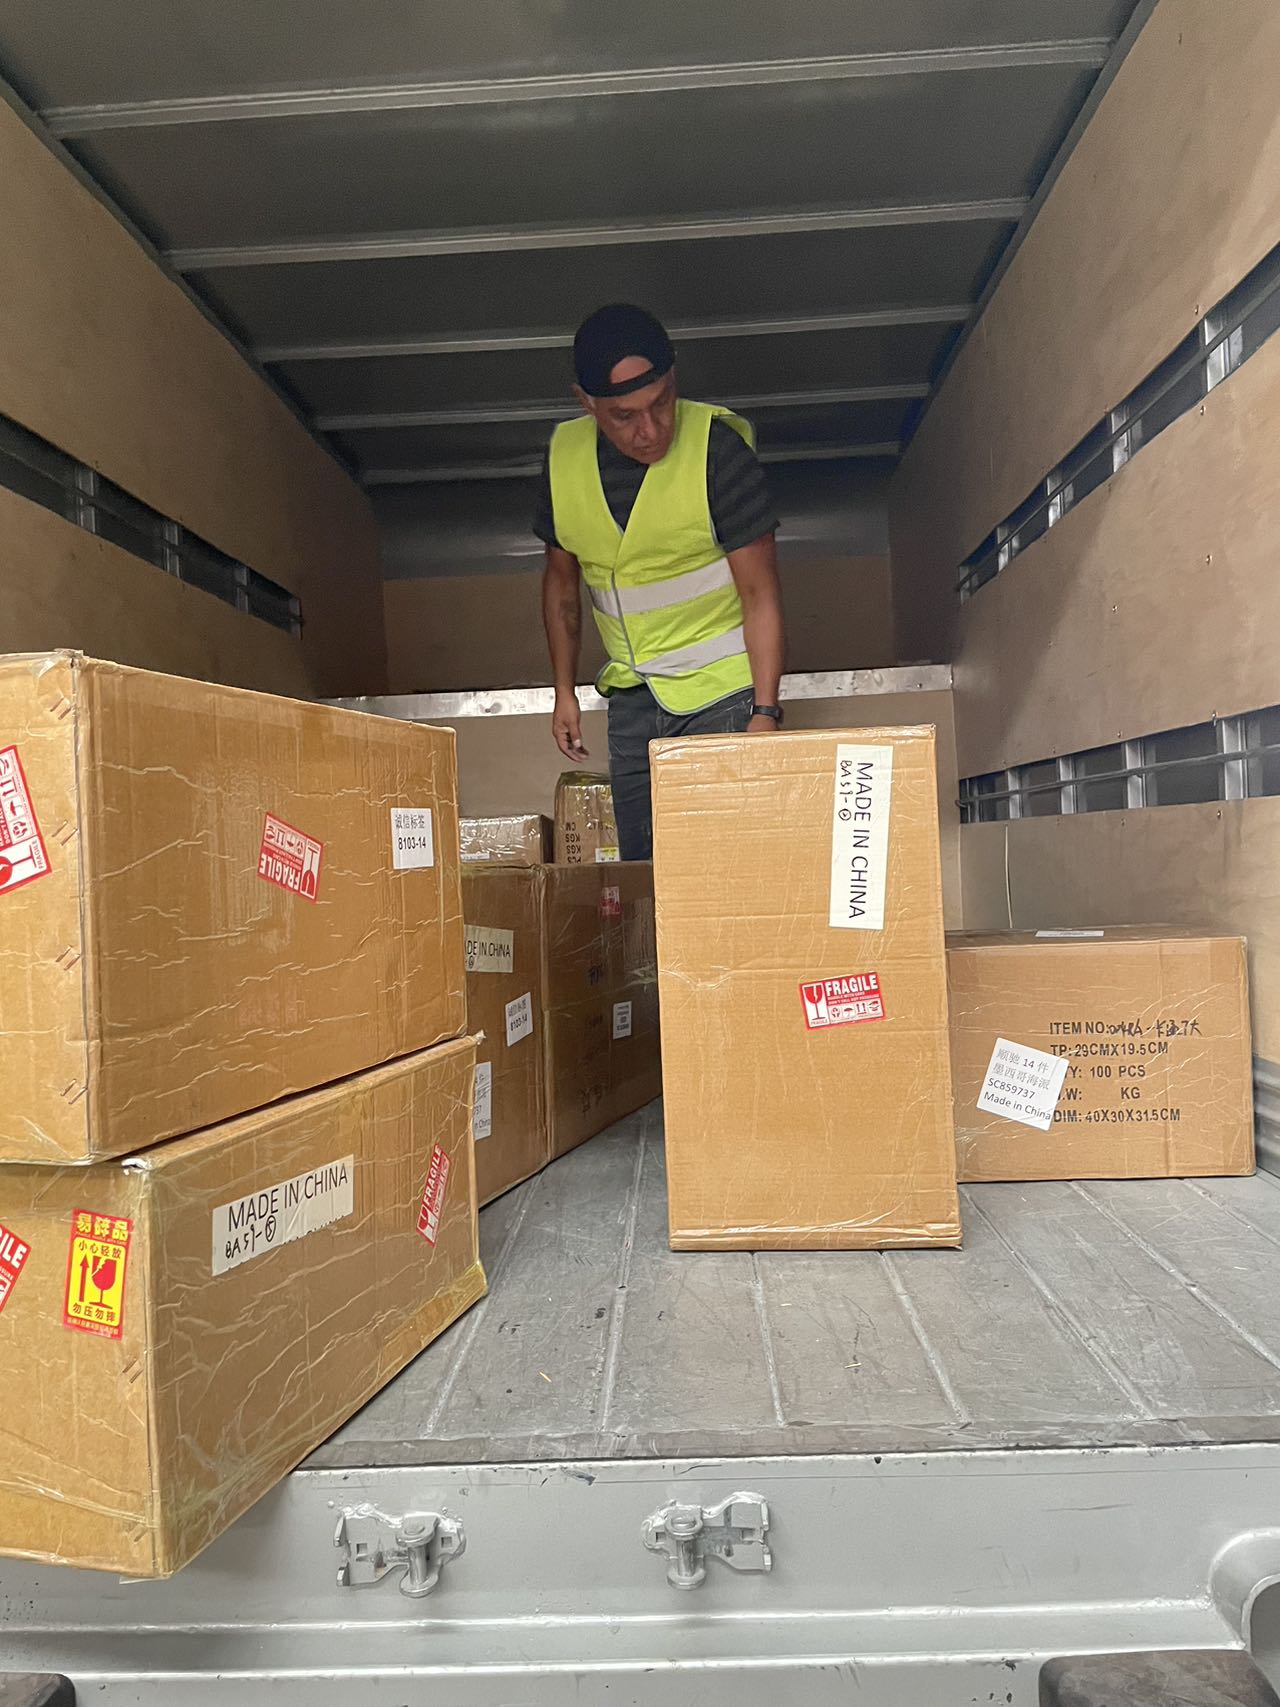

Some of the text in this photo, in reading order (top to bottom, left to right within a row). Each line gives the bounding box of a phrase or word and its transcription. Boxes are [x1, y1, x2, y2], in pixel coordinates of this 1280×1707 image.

[398, 836, 426, 850] 8103-14
[565, 833, 580, 842] KGS
[848, 762, 874, 919] MADE IN CHINA
[567, 845, 581, 854] KGS
[259, 853, 301, 891] FRAGILE
[480, 942, 487, 956] IN
[488, 943, 511, 957] CHINA
[825, 974, 879, 997] FRAGILE
[1050, 1021, 1081, 1034] ITEM
[1051, 1044, 1072, 1057] TP:
[1023, 1058, 1034, 1068] 14
[1090, 1065, 1111, 1077] 100
[1119, 1065, 1146, 1077] PCS
[987, 1077, 1035, 1099] SC859737
[1121, 1087, 1141, 1099] KG
[984, 1091, 1051, 1120] Made in China
[1053, 1110, 1082, 1123] DIM:
[423, 1144, 442, 1206] FRAGILE
[229, 1188, 279, 1232] MADE
[284, 1180, 300, 1209] IN
[304, 1163, 348, 1199] CHINA
[77, 1212, 129, 1241] 易碎品
[0, 1228, 27, 1269] ILE
[78, 1240, 122, 1259] 小心轻放
[72, 1303, 116, 1322] 勿压勿摔
